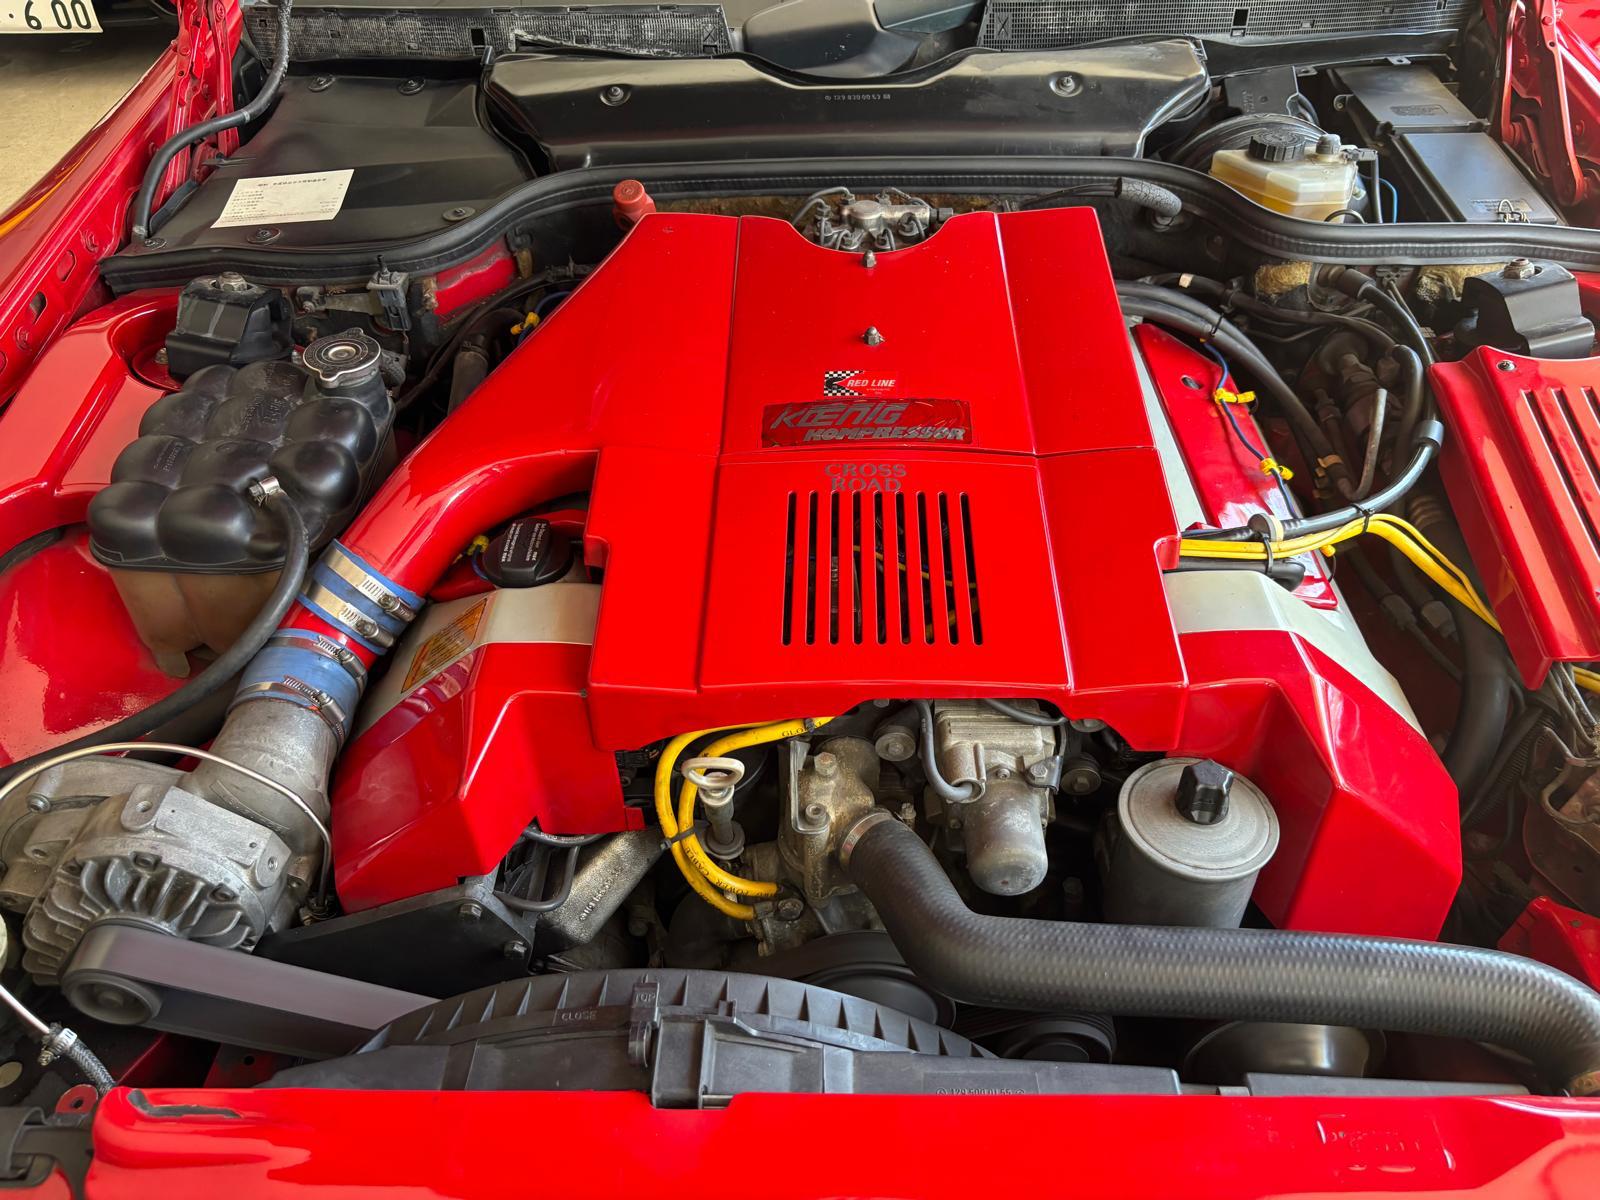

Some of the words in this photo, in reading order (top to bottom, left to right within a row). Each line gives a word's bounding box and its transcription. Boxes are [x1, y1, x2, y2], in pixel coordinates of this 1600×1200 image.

[846, 379, 869, 387] RED
[871, 379, 896, 387] LINE
[803, 425, 966, 442] KOMPRESSOR
[824, 463, 907, 477] CROSS
[830, 477, 902, 492] ROAD
[685, 847, 710, 877] CABLE
[715, 879, 749, 896] POWER
[635, 991, 657, 1003] TOP
[561, 1010, 598, 1022] CLOSE
